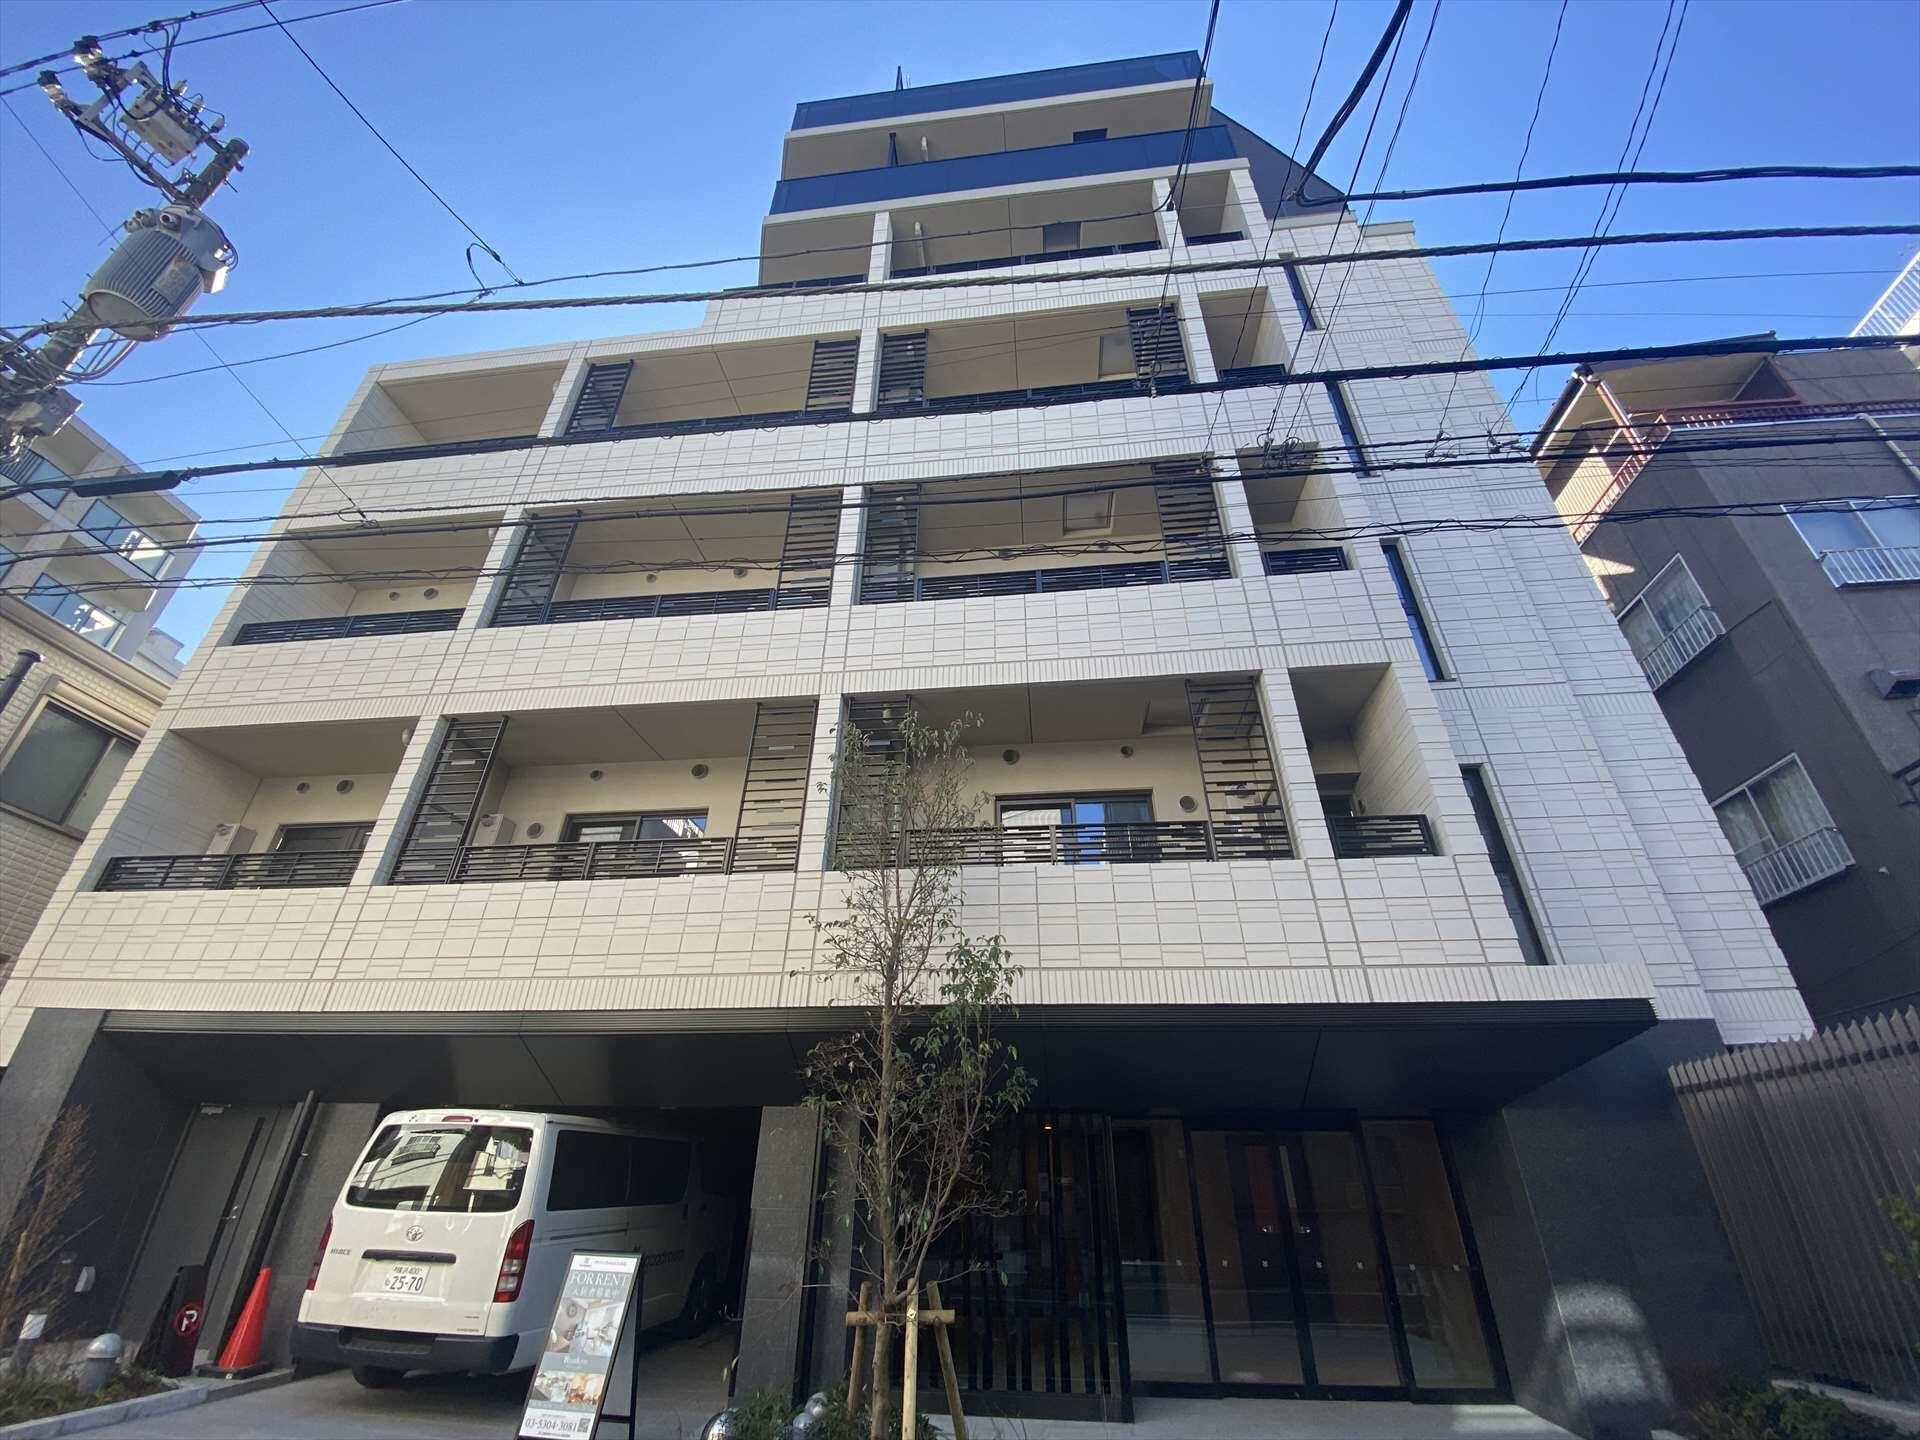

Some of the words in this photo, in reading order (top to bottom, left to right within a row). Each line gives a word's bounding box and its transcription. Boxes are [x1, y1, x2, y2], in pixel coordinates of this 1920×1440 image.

[390, 1275, 424, 1291] 25-70
[569, 1271, 594, 1285] FOR
[595, 1273, 631, 1287] RENT
